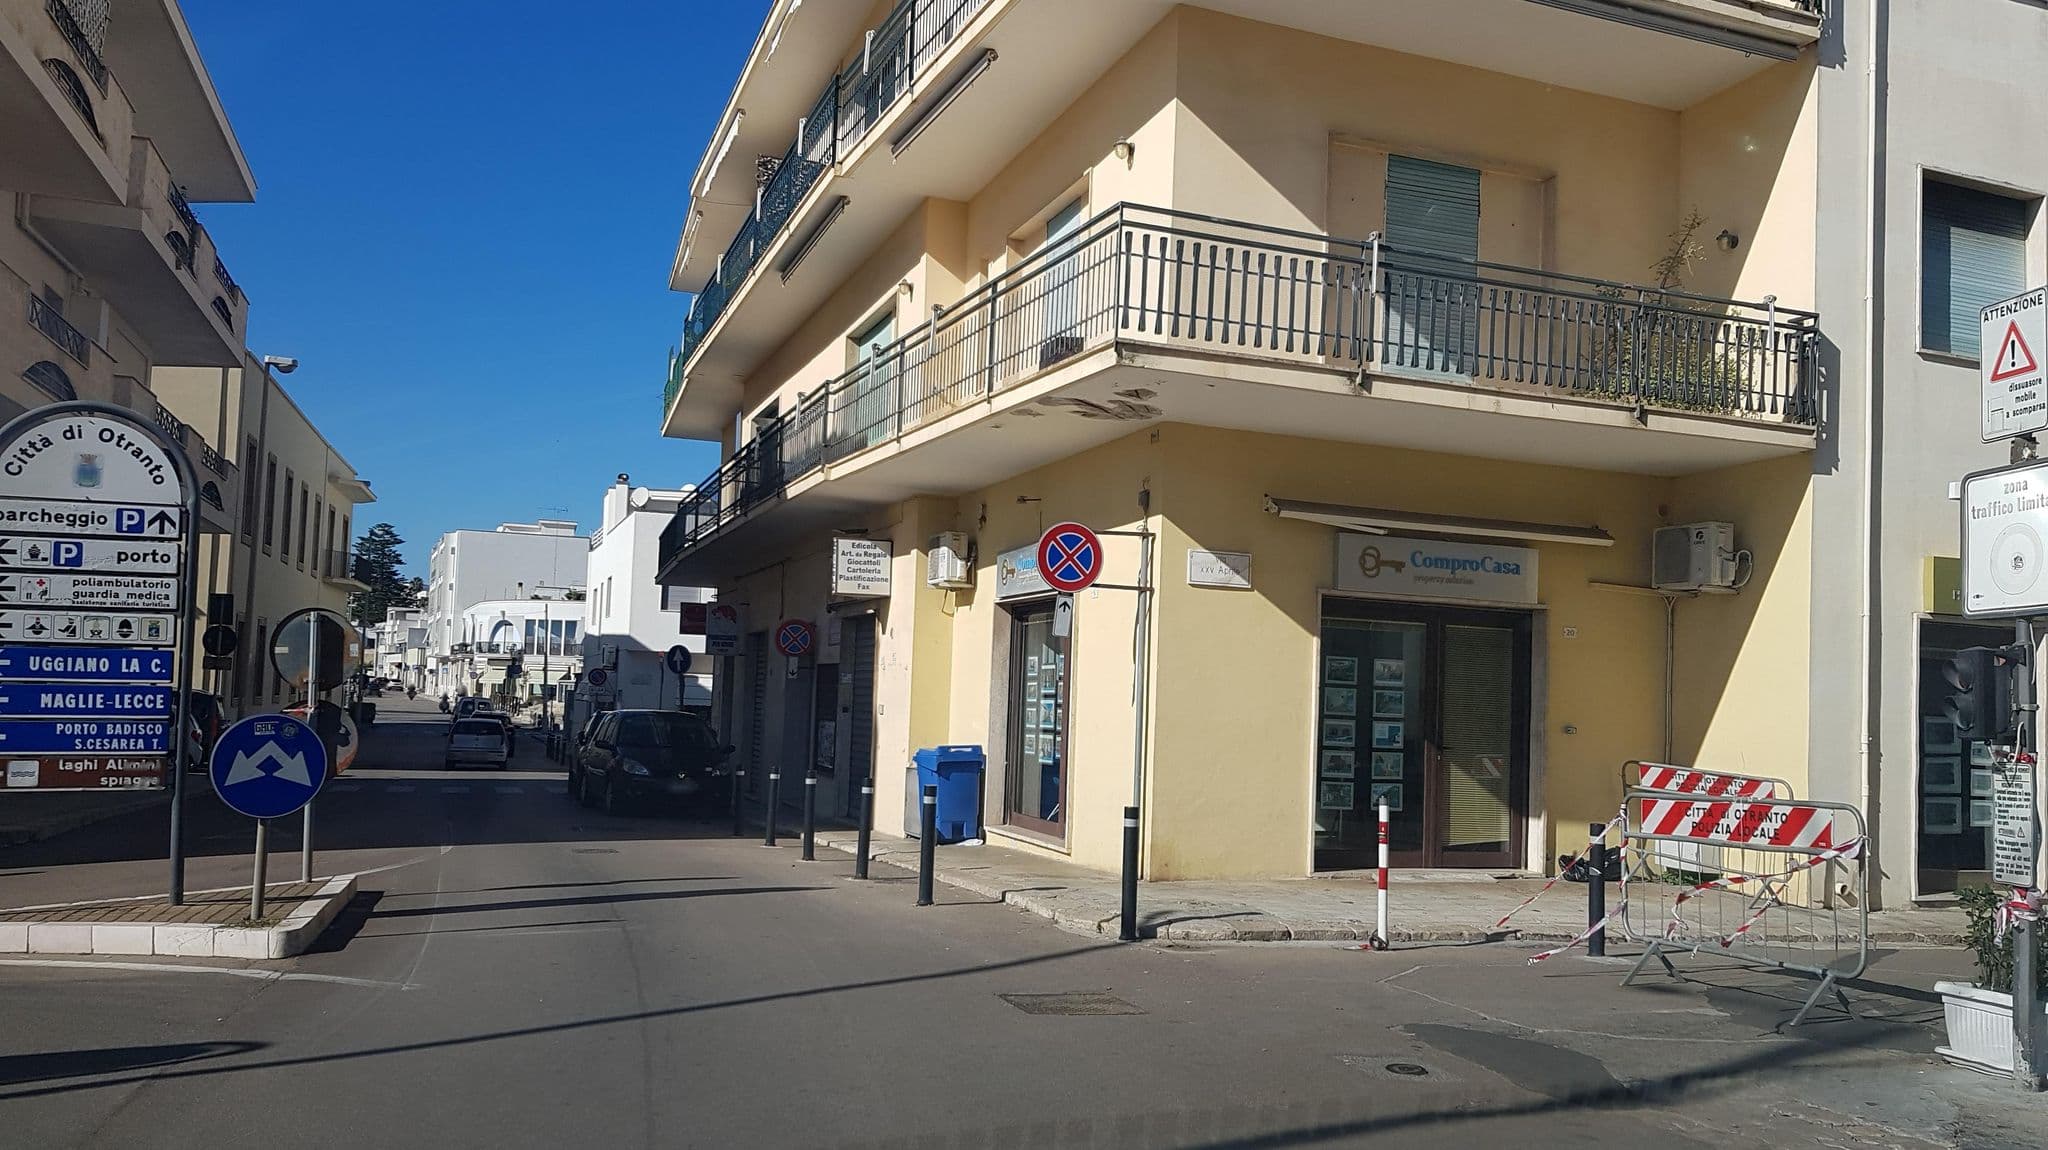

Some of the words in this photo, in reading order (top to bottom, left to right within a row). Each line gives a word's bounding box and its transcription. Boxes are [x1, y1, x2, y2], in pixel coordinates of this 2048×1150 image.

[1983, 293, 2044, 323] ATTENZIONE
[2008, 377, 2043, 393] dissuasore
[2014, 390, 2037, 404] mobile
[2005, 410, 2010, 418] a
[2012, 402, 2046, 417] scomparsa
[4, 434, 54, 476] Città
[62, 425, 83, 440] di
[98, 428, 165, 486] Otranto
[2003, 479, 2029, 495] zona
[1971, 500, 2014, 520] traffico
[851, 542, 877, 550] Edicola
[117, 549, 171, 564] porto
[863, 551, 887, 559] Regalo
[1410, 550, 1521, 576] ComproCasa
[72, 578, 171, 589] poliambulatorio
[839, 574, 889, 583] Plastificazione
[72, 589, 120, 600] guardia
[126, 591, 170, 601] medica
[29, 655, 110, 672] UGGIANO
[121, 658, 140, 673] LA
[151, 658, 166, 673] C.
[40, 693, 165, 709] MAGLIE-LECCE
[56, 723, 98, 735] PORTO
[106, 723, 163, 735] BADISCO
[75, 738, 145, 750] S.CESAREA
[152, 739, 162, 750] T.
[1734, 809, 1789, 825] OTRANTO
[1691, 821, 1732, 835] POLIZIA
[1736, 826, 1780, 840] LOCALE
